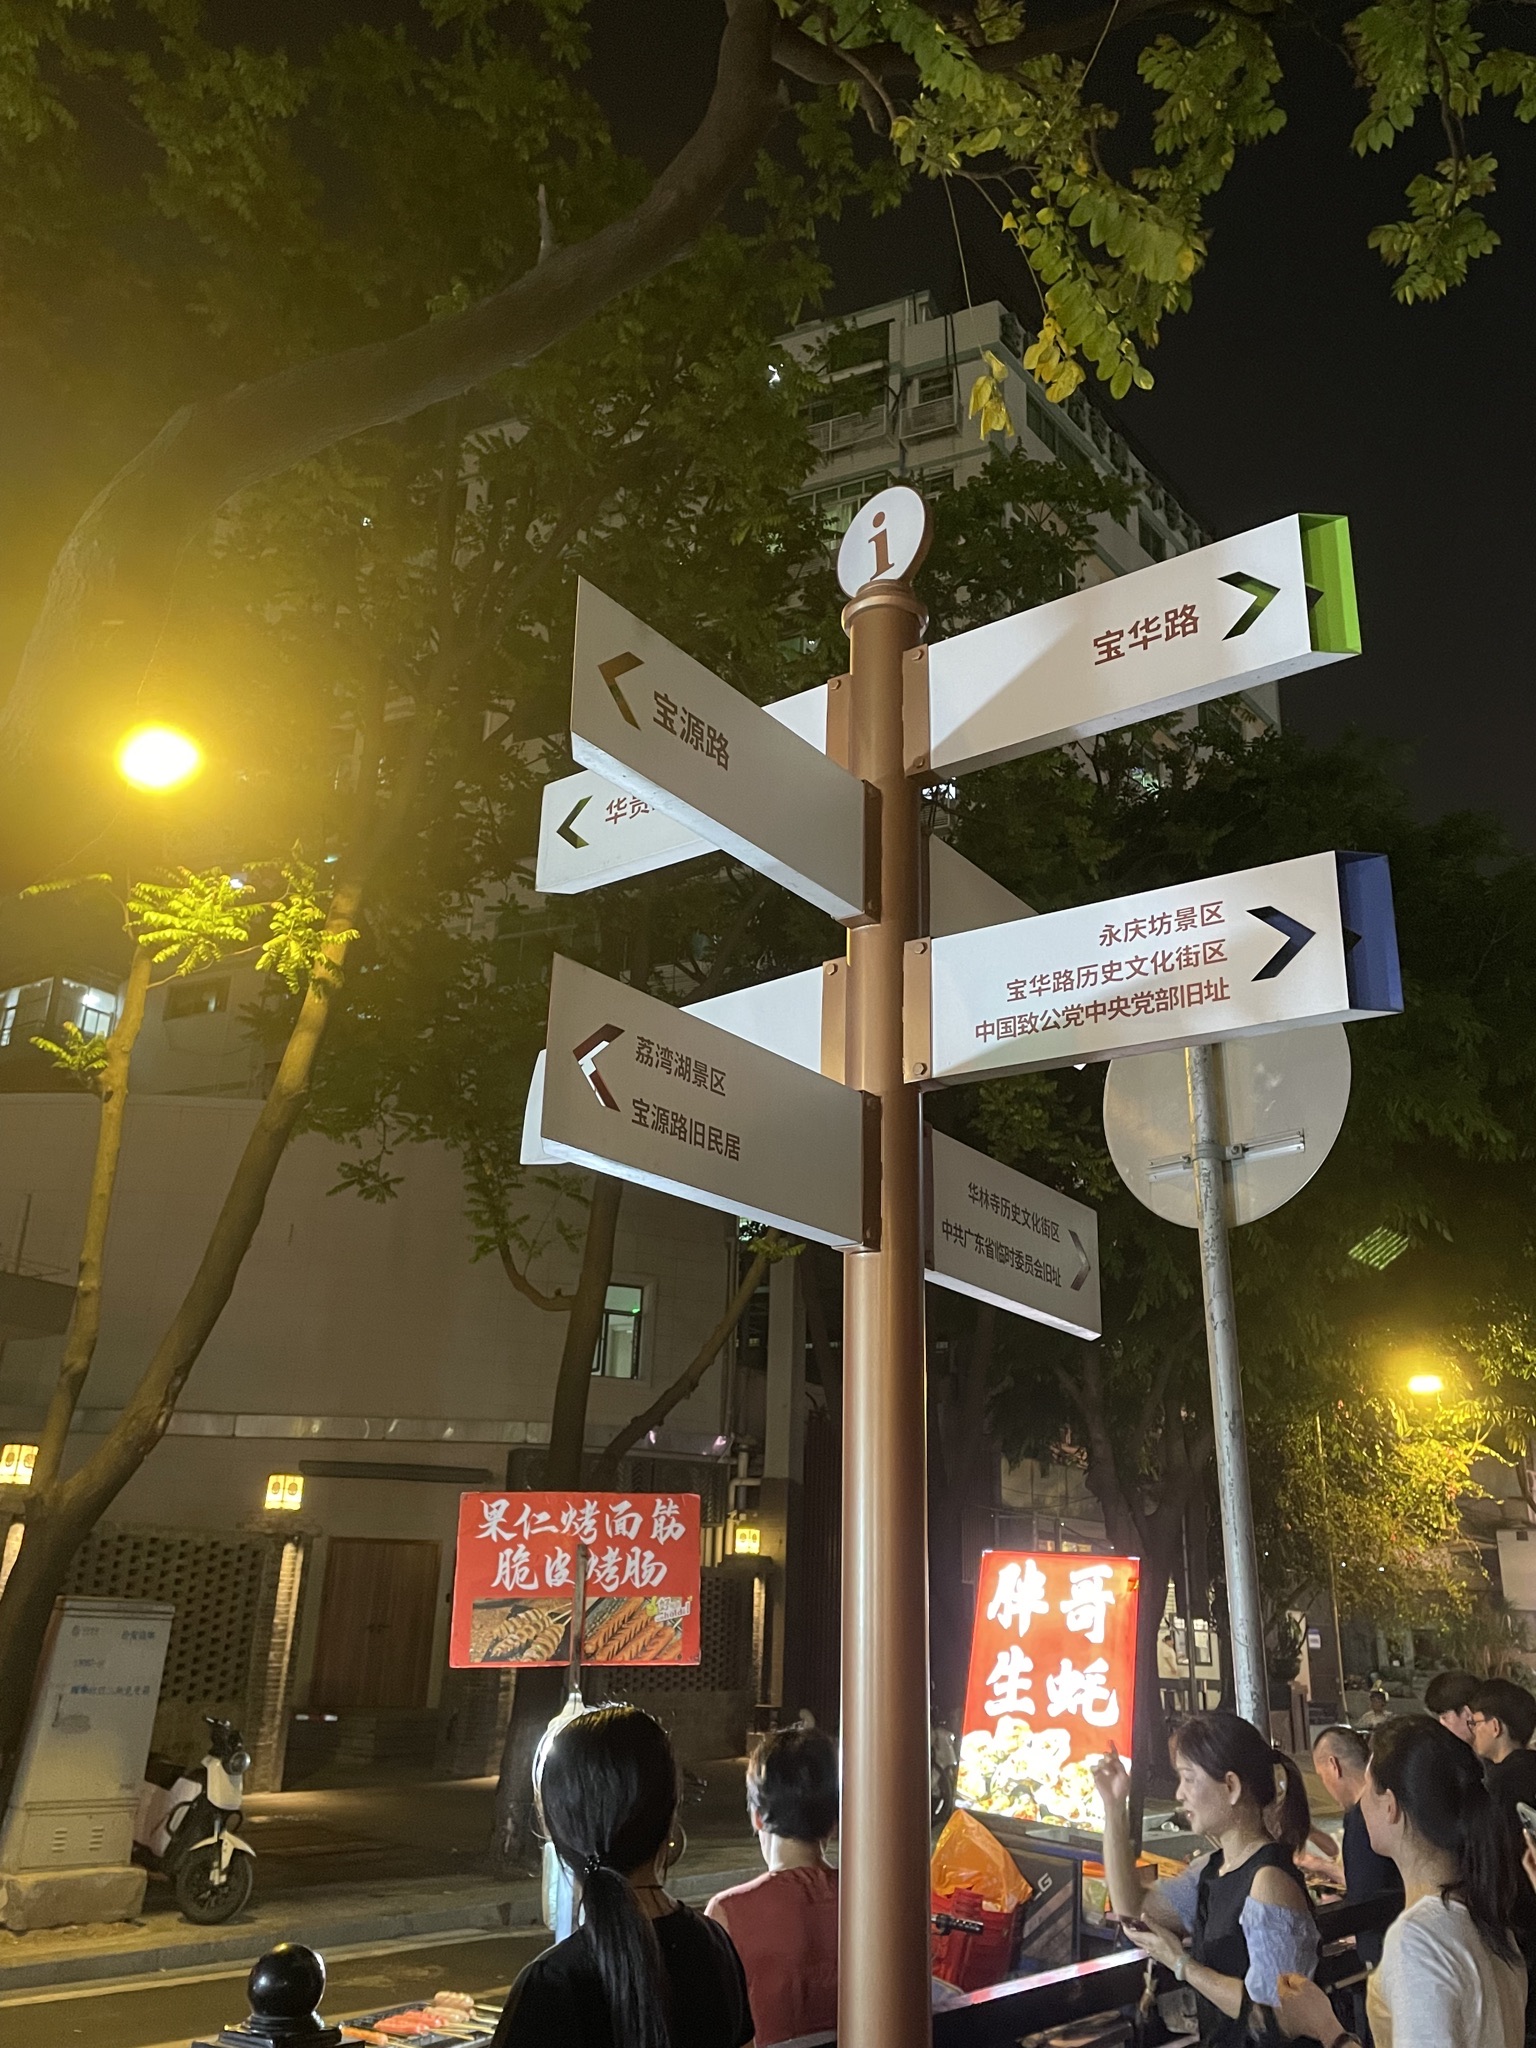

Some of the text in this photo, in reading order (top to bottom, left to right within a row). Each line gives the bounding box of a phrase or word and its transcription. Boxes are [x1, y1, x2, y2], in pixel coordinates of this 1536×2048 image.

[1093, 603, 1200, 666] 宝华路
[652, 690, 730, 771] 宝源路
[1099, 900, 1225, 947] 永庆坊景区
[1006, 938, 1228, 1002] 宝华路历史文化街区
[975, 976, 1231, 1043] 中国致公党中央党部旧址
[635, 1035, 727, 1097] 荔湾湖景区
[631, 1098, 741, 1162] 宝源路旧民居
[967, 1181, 1061, 1243] 华林寺历史文化街区
[941, 1218, 1062, 1288] 中共广东省临时委员会旧址
[474, 1497, 686, 1546] 果仁烤面筋
[490, 1543, 668, 1593] 脆皮烤肠
[986, 1558, 1116, 1644] 胖哥
[984, 1645, 1120, 1728] 生蚝
